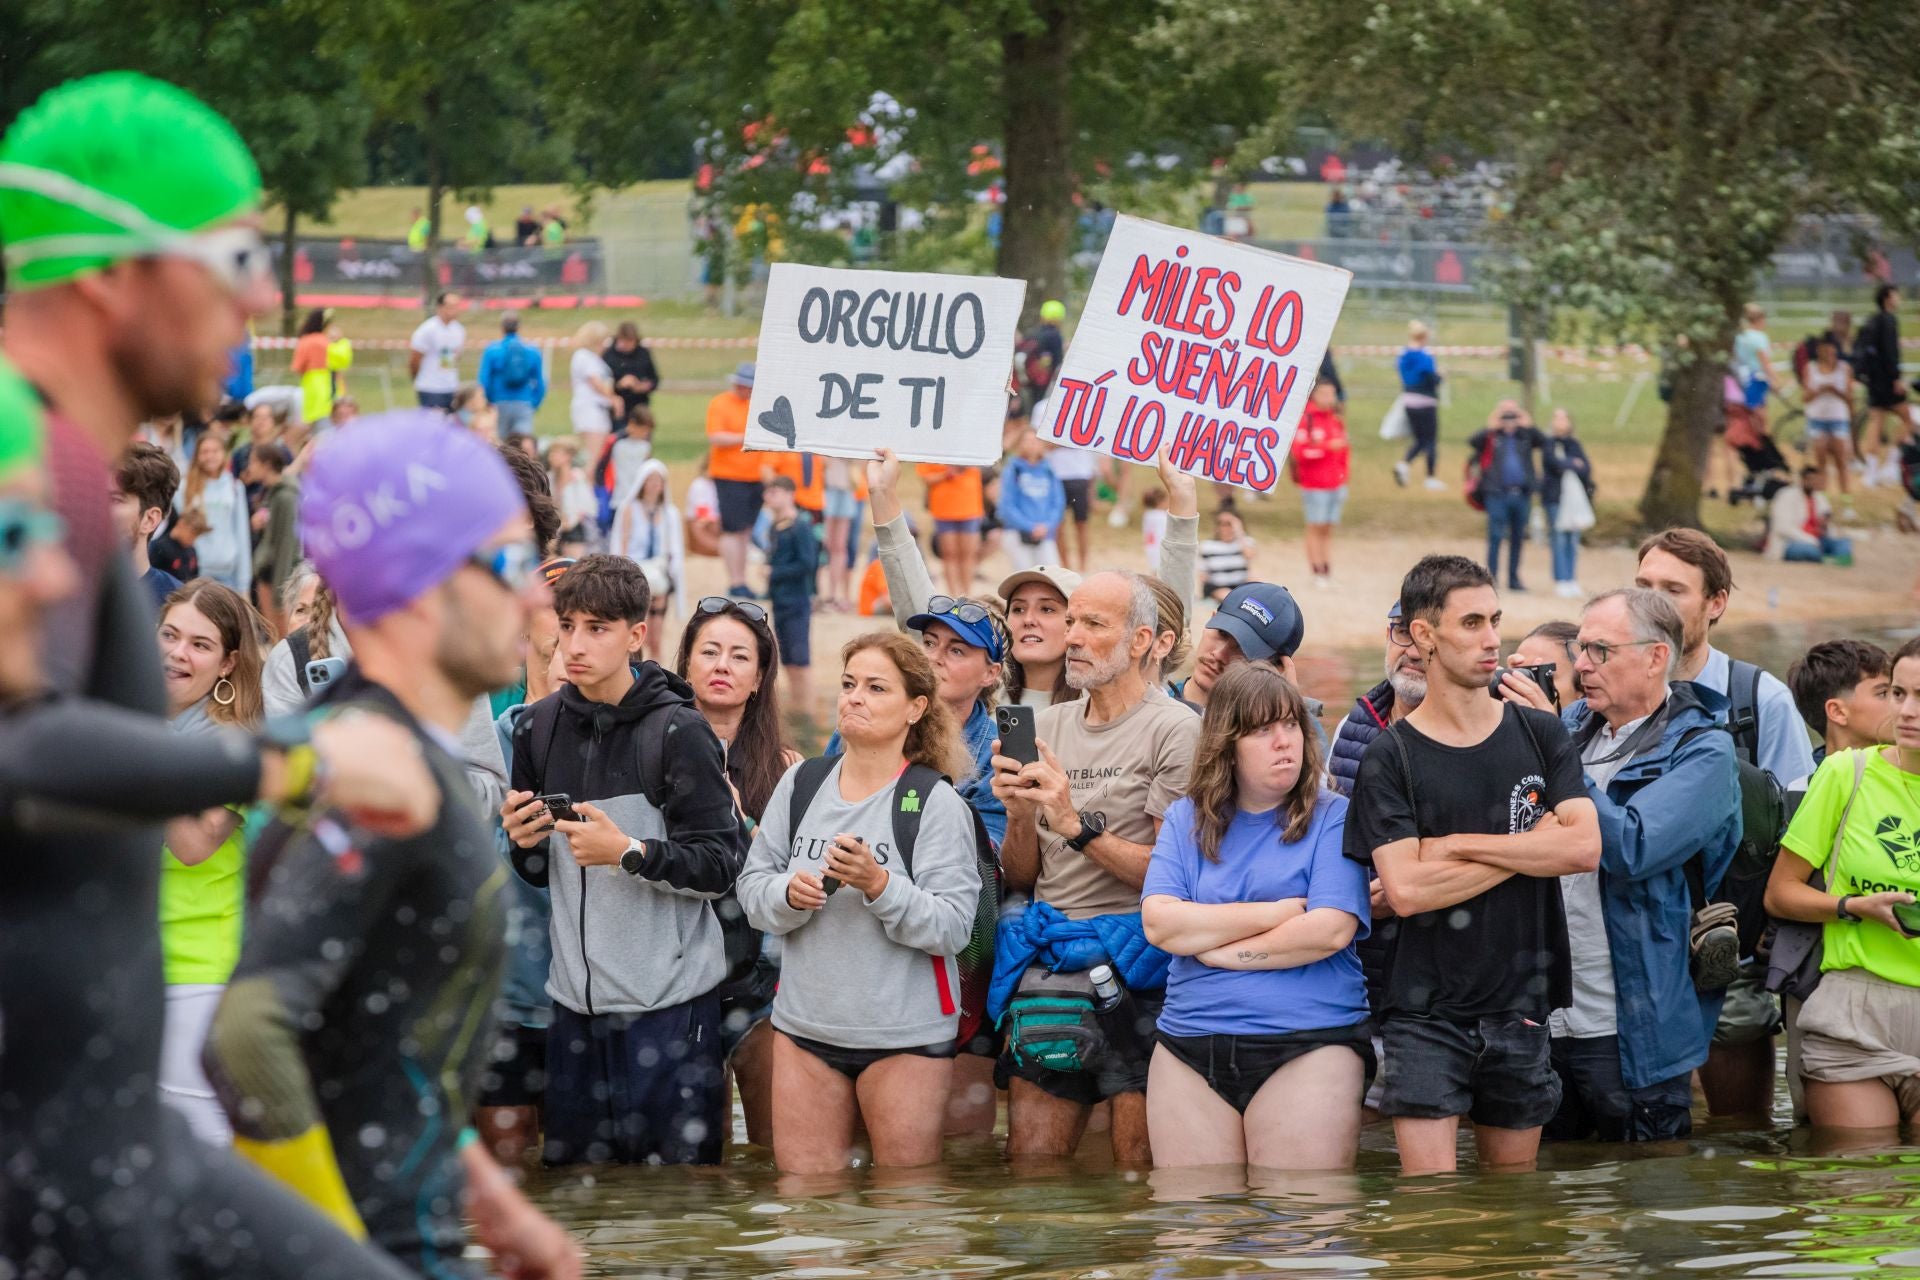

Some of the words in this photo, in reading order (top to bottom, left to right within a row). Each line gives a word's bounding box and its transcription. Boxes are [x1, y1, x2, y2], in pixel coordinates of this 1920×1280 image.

[798, 286, 985, 359] ORGULLO
[1245, 285, 1303, 356] LO
[816, 372, 884, 419] DE
[899, 376, 945, 430] TI
[1127, 331, 1298, 421] SUEÑAN
[1112, 395, 1166, 462] LO
[1169, 411, 1280, 491] HACES
[1241, 603, 1268, 625] patagonia
[1081, 767, 1123, 779] BLANC
[792, 836, 890, 866] GUS
